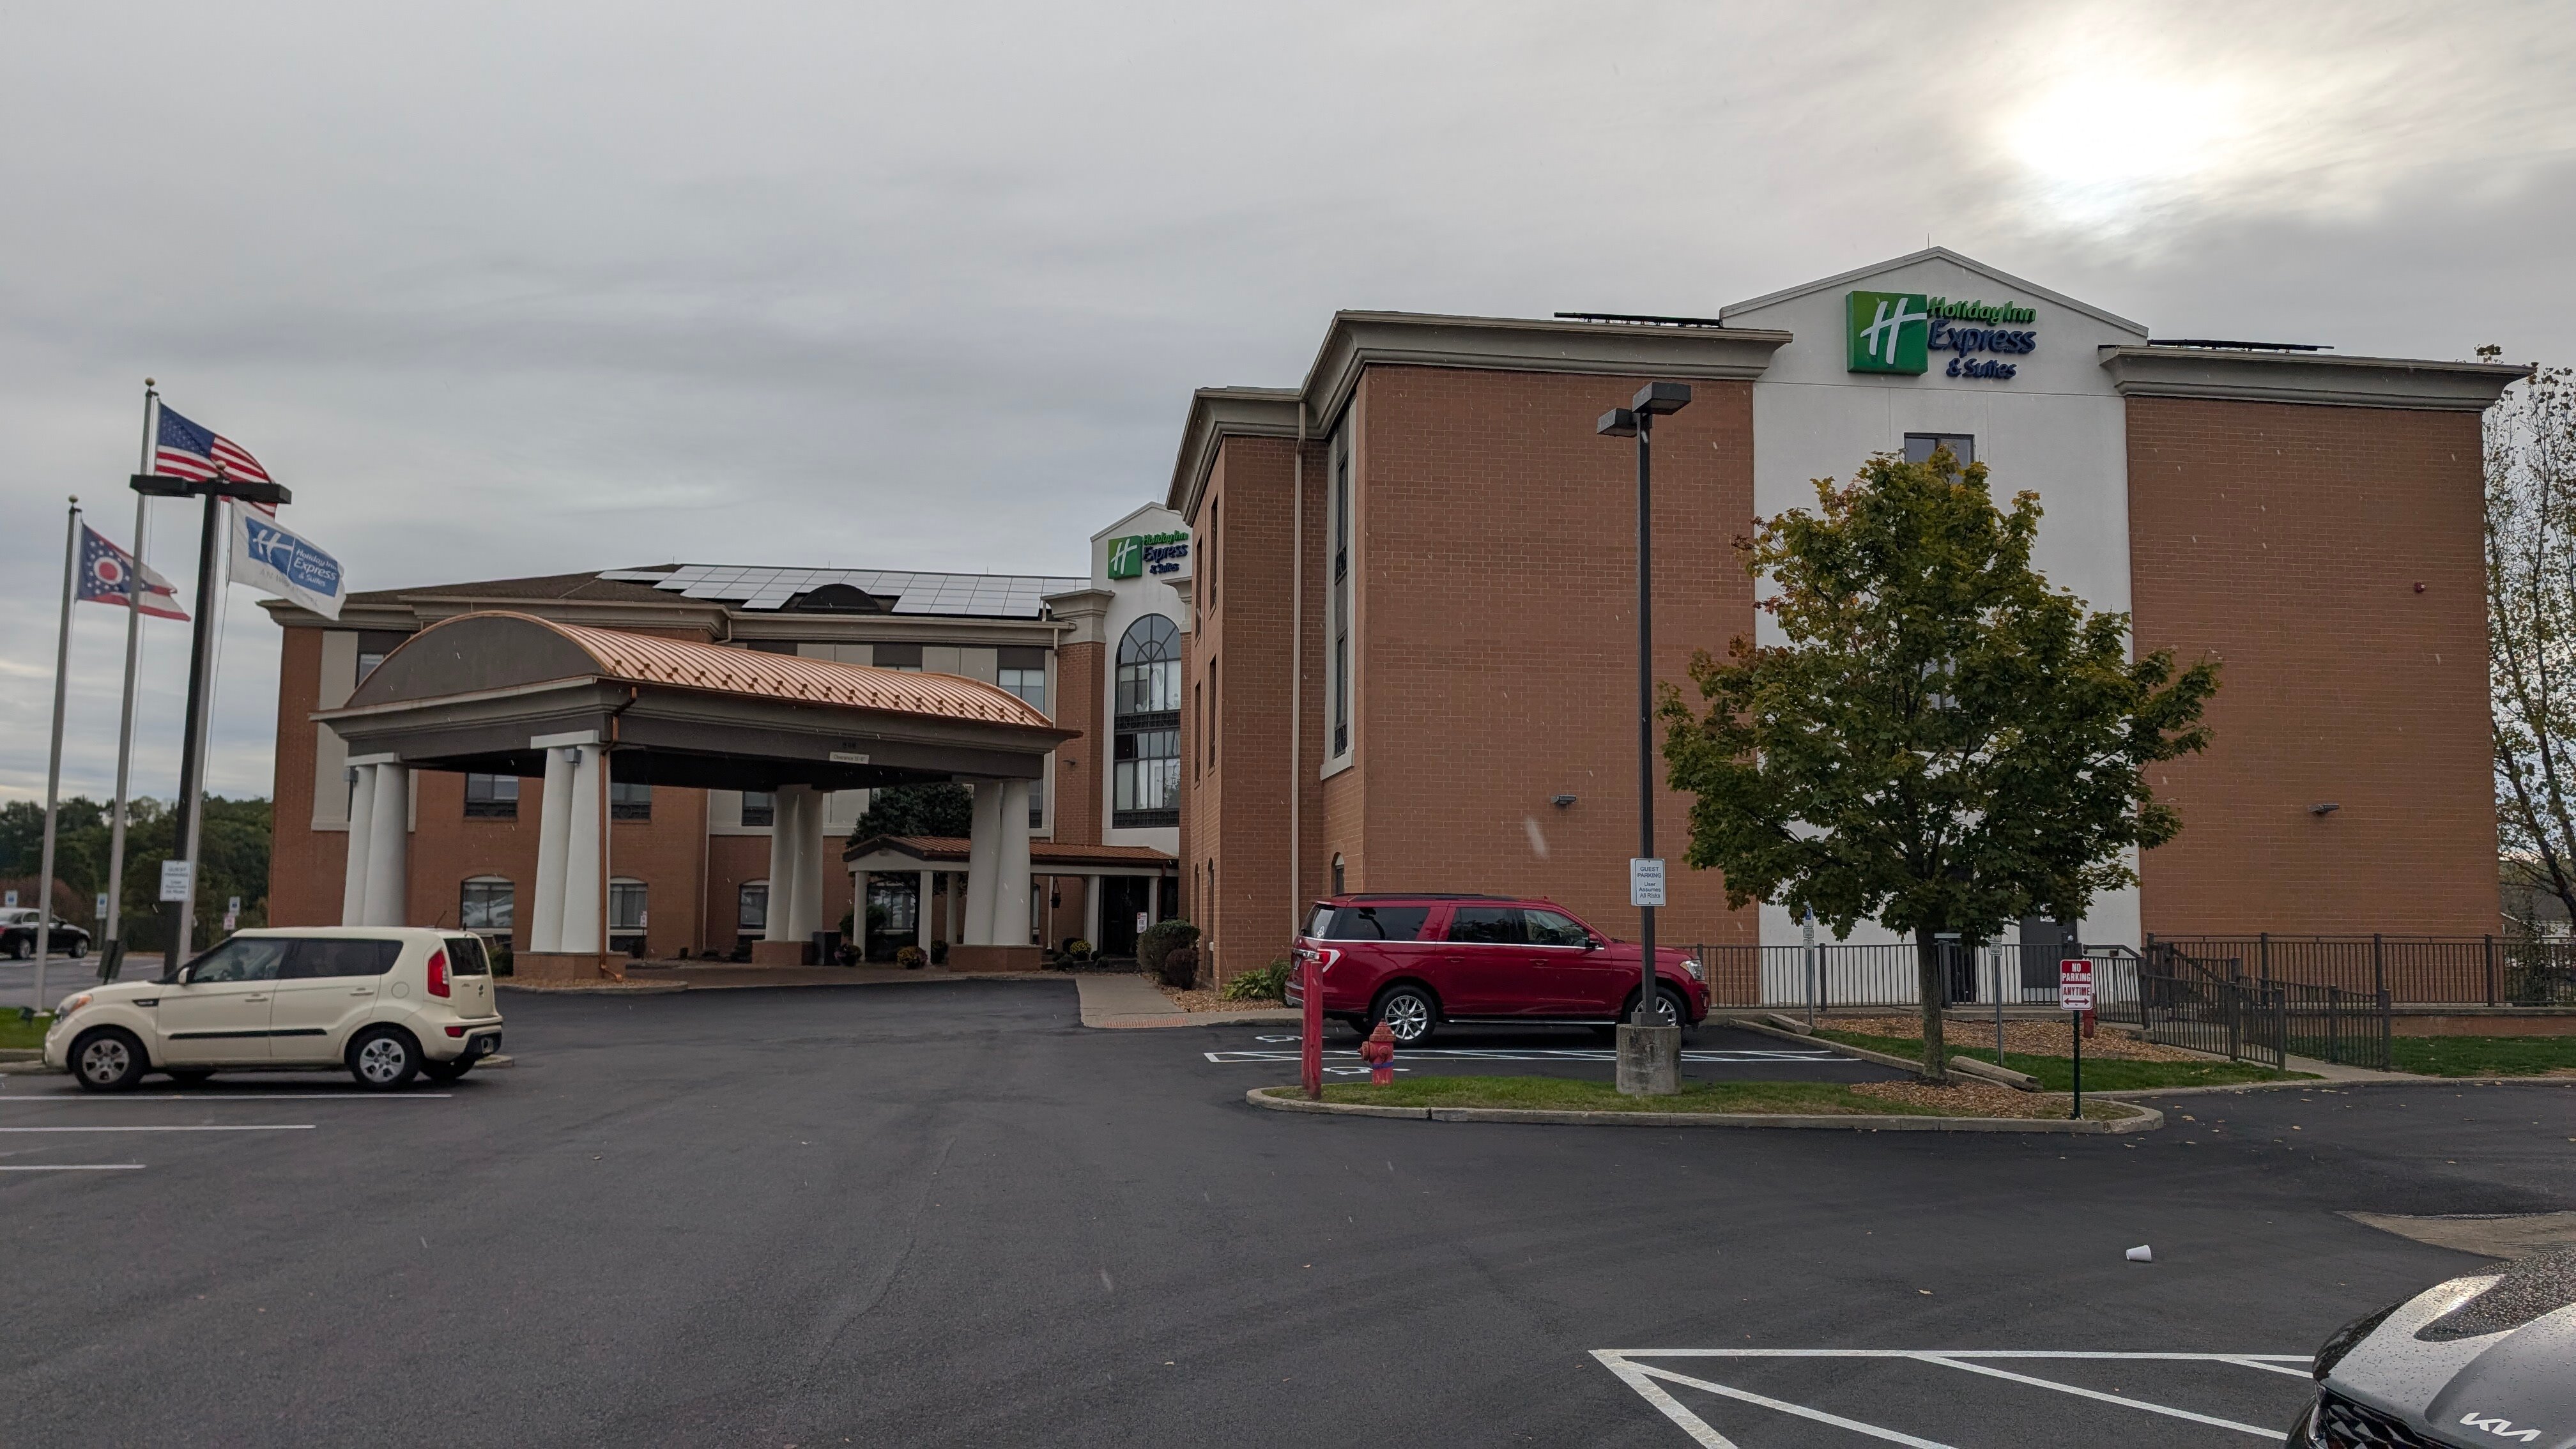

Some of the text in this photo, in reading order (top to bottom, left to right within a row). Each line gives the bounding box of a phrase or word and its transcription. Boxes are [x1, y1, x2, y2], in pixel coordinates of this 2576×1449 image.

[1928, 297, 2037, 326] Holiday Inn
[1928, 320, 2037, 358] Express
[1946, 358, 2018, 379] & Suites
[1143, 530, 1188, 546] Holiday Inn
[296, 549, 325, 567] Holiday
[1143, 544, 1188, 563] Express
[294, 556, 337, 581] Express
[1149, 565, 1157, 574] &
[2072, 963, 2082, 972] NO
[2062, 973, 2091, 982] PARKING
[2063, 986, 2090, 996] ANYTIME
